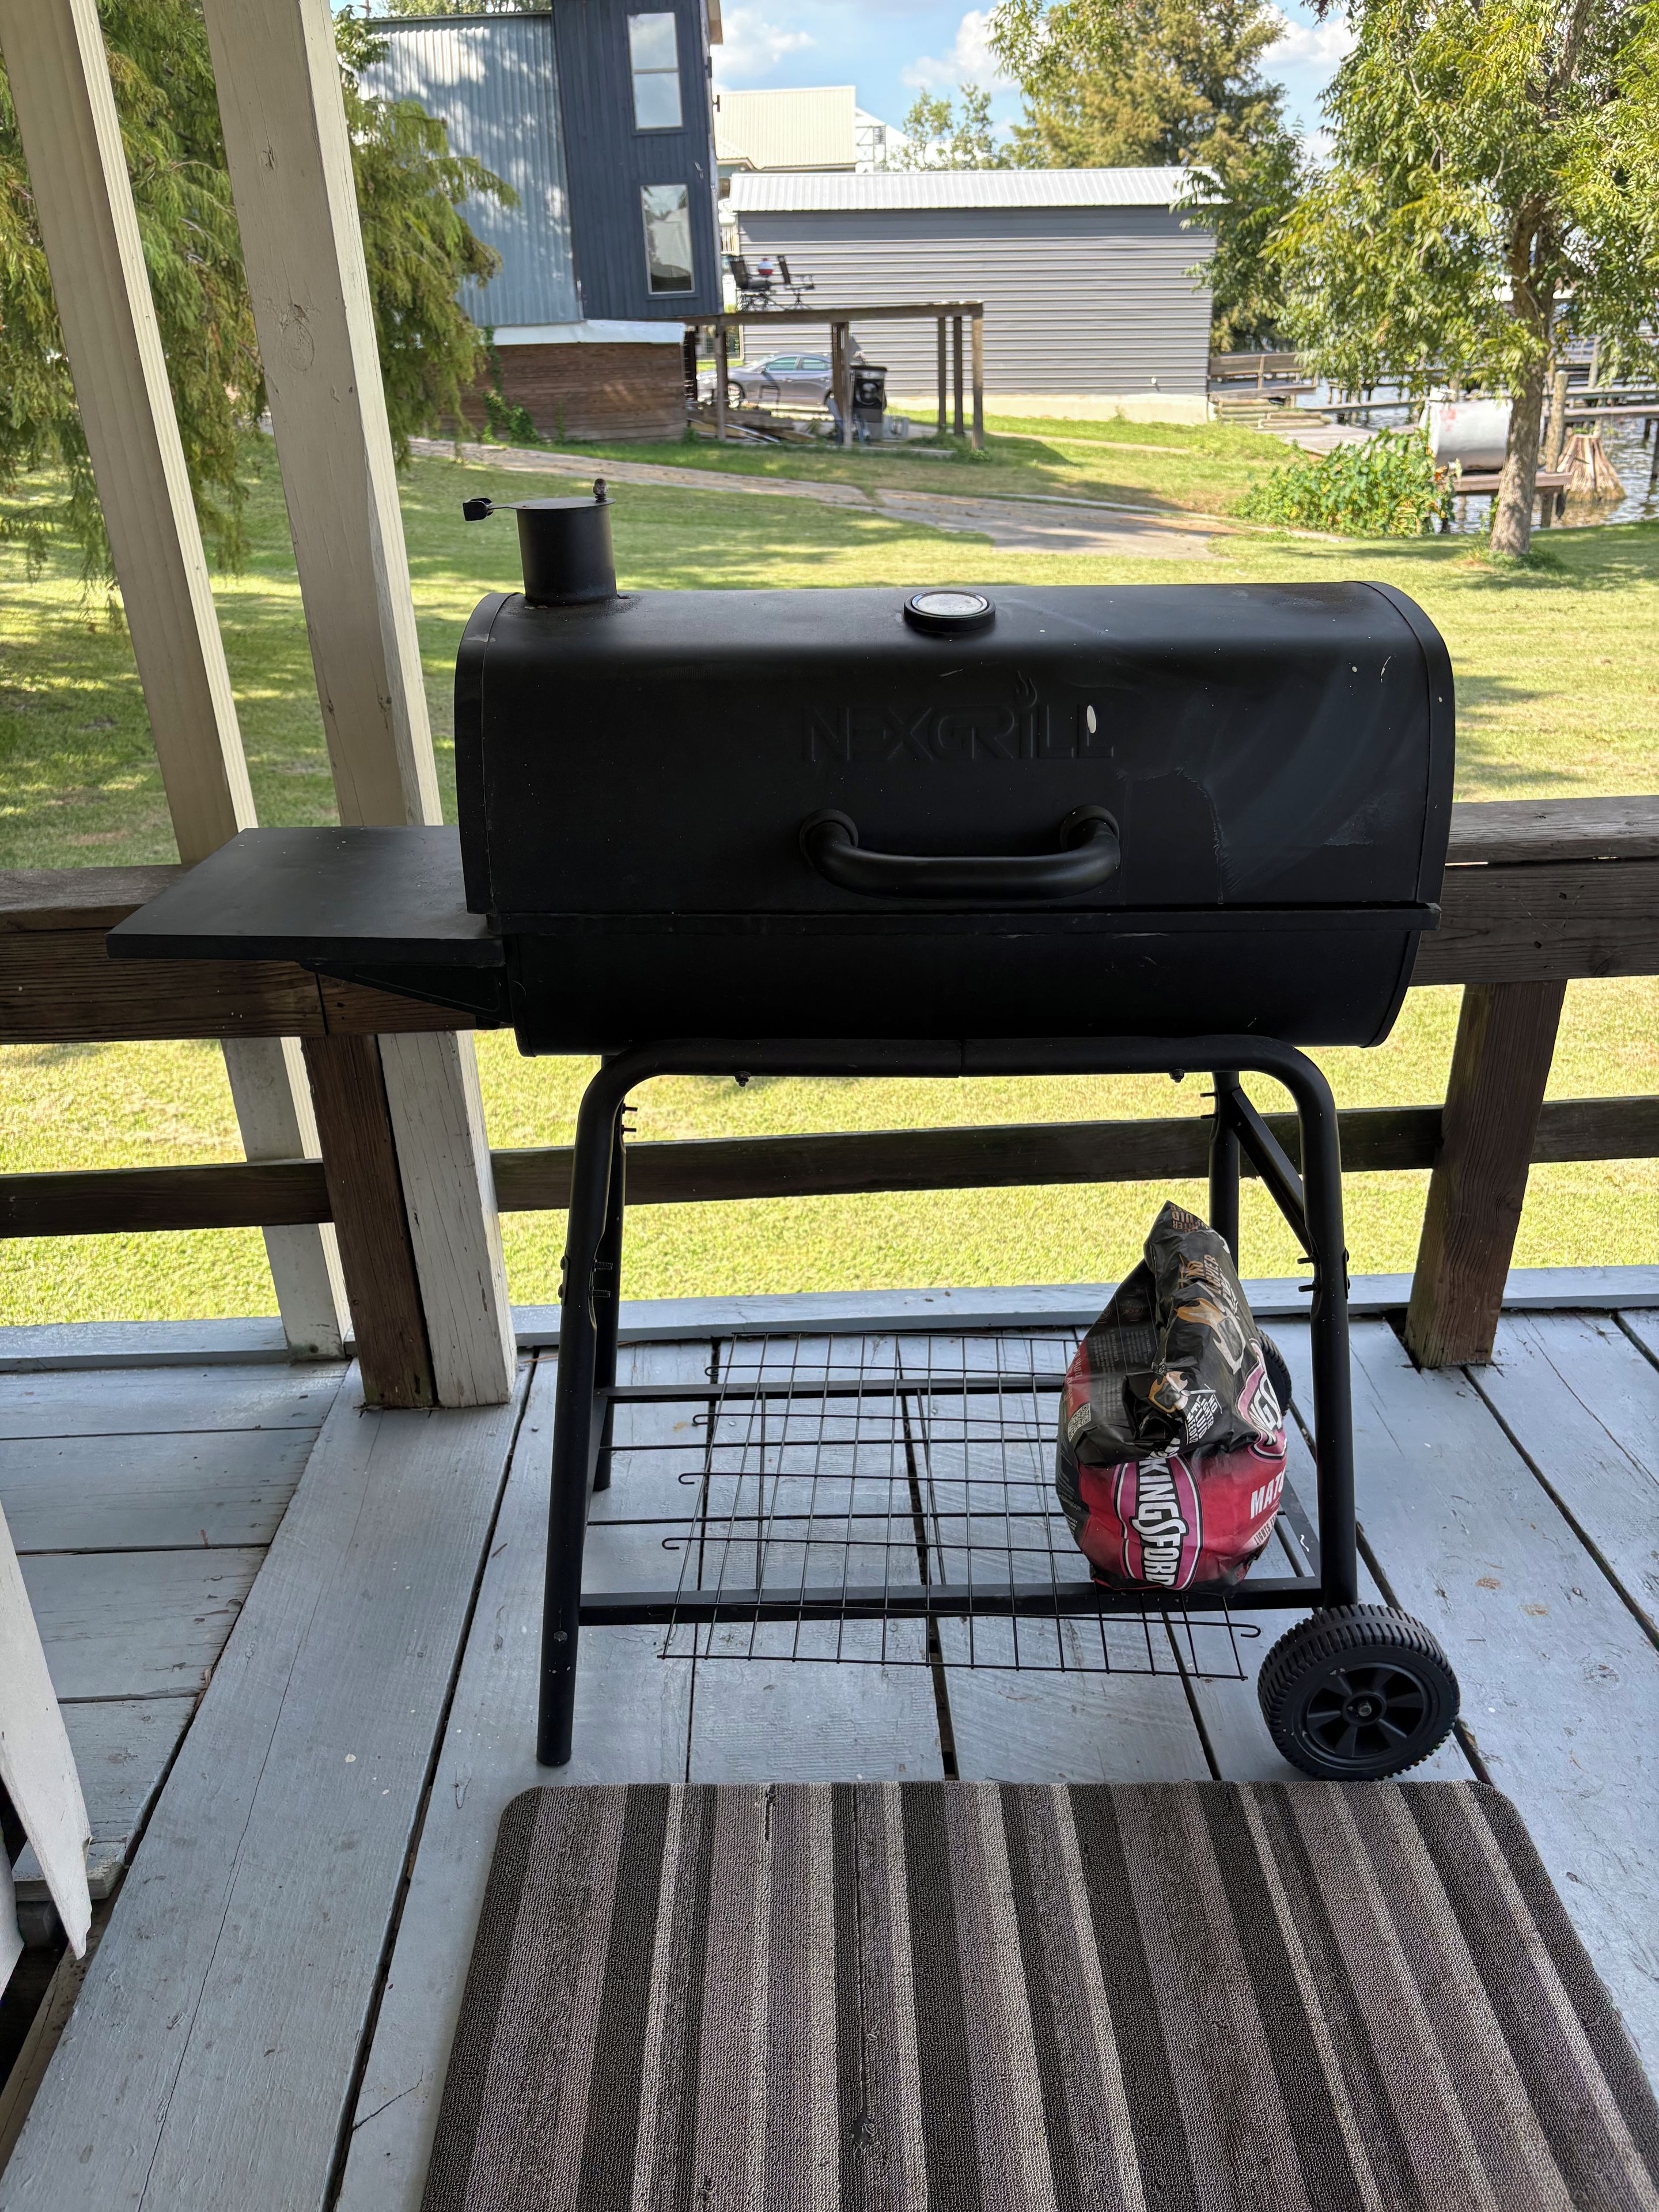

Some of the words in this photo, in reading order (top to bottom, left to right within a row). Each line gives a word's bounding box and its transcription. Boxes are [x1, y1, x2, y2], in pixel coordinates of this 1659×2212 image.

[1190, 1402, 1207, 1440] FLUID
[1196, 1394, 1214, 1430] LIGHTER
[1208, 1394, 1218, 1414] NO
[1186, 1412, 1199, 1444] NEEDED
[1131, 1458, 1187, 1586] KINGSFORD
[1253, 1522, 1271, 1546] LIGHTS
